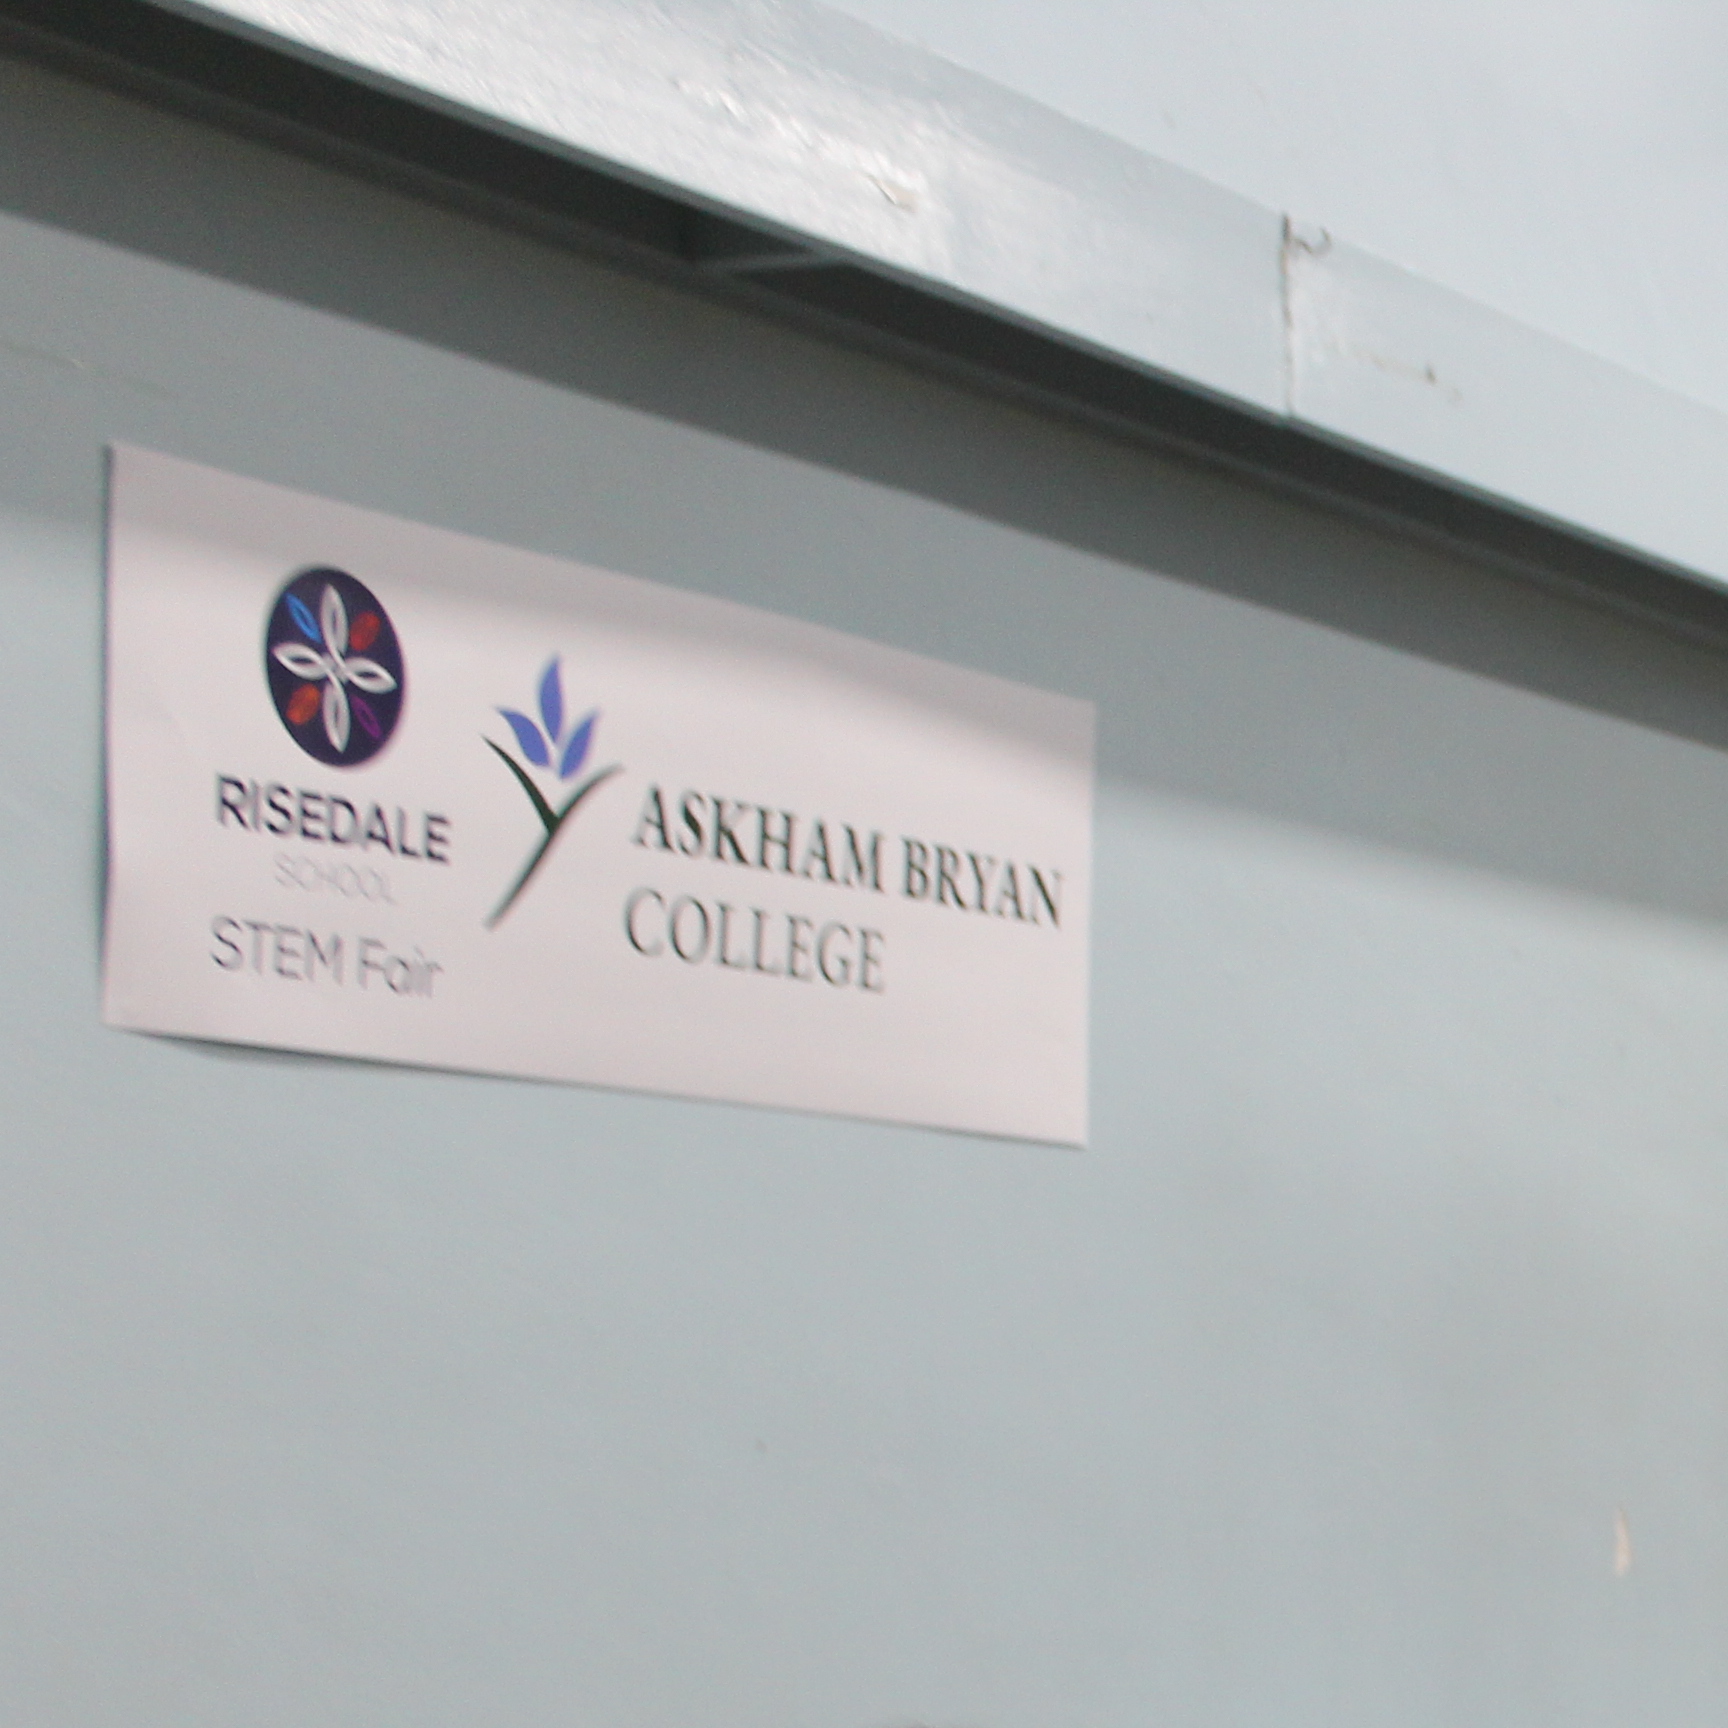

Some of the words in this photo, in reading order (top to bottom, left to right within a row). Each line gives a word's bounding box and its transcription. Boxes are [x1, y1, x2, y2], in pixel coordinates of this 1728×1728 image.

[216, 772, 452, 865] RISEDALE
[632, 785, 889, 896] ASKHAM
[898, 832, 1065, 931] BRYAN
[273, 853, 396, 907] SCHOOL
[210, 916, 347, 987] STEM
[355, 939, 445, 1000] Fair
[622, 887, 887, 995] COLLEGE
